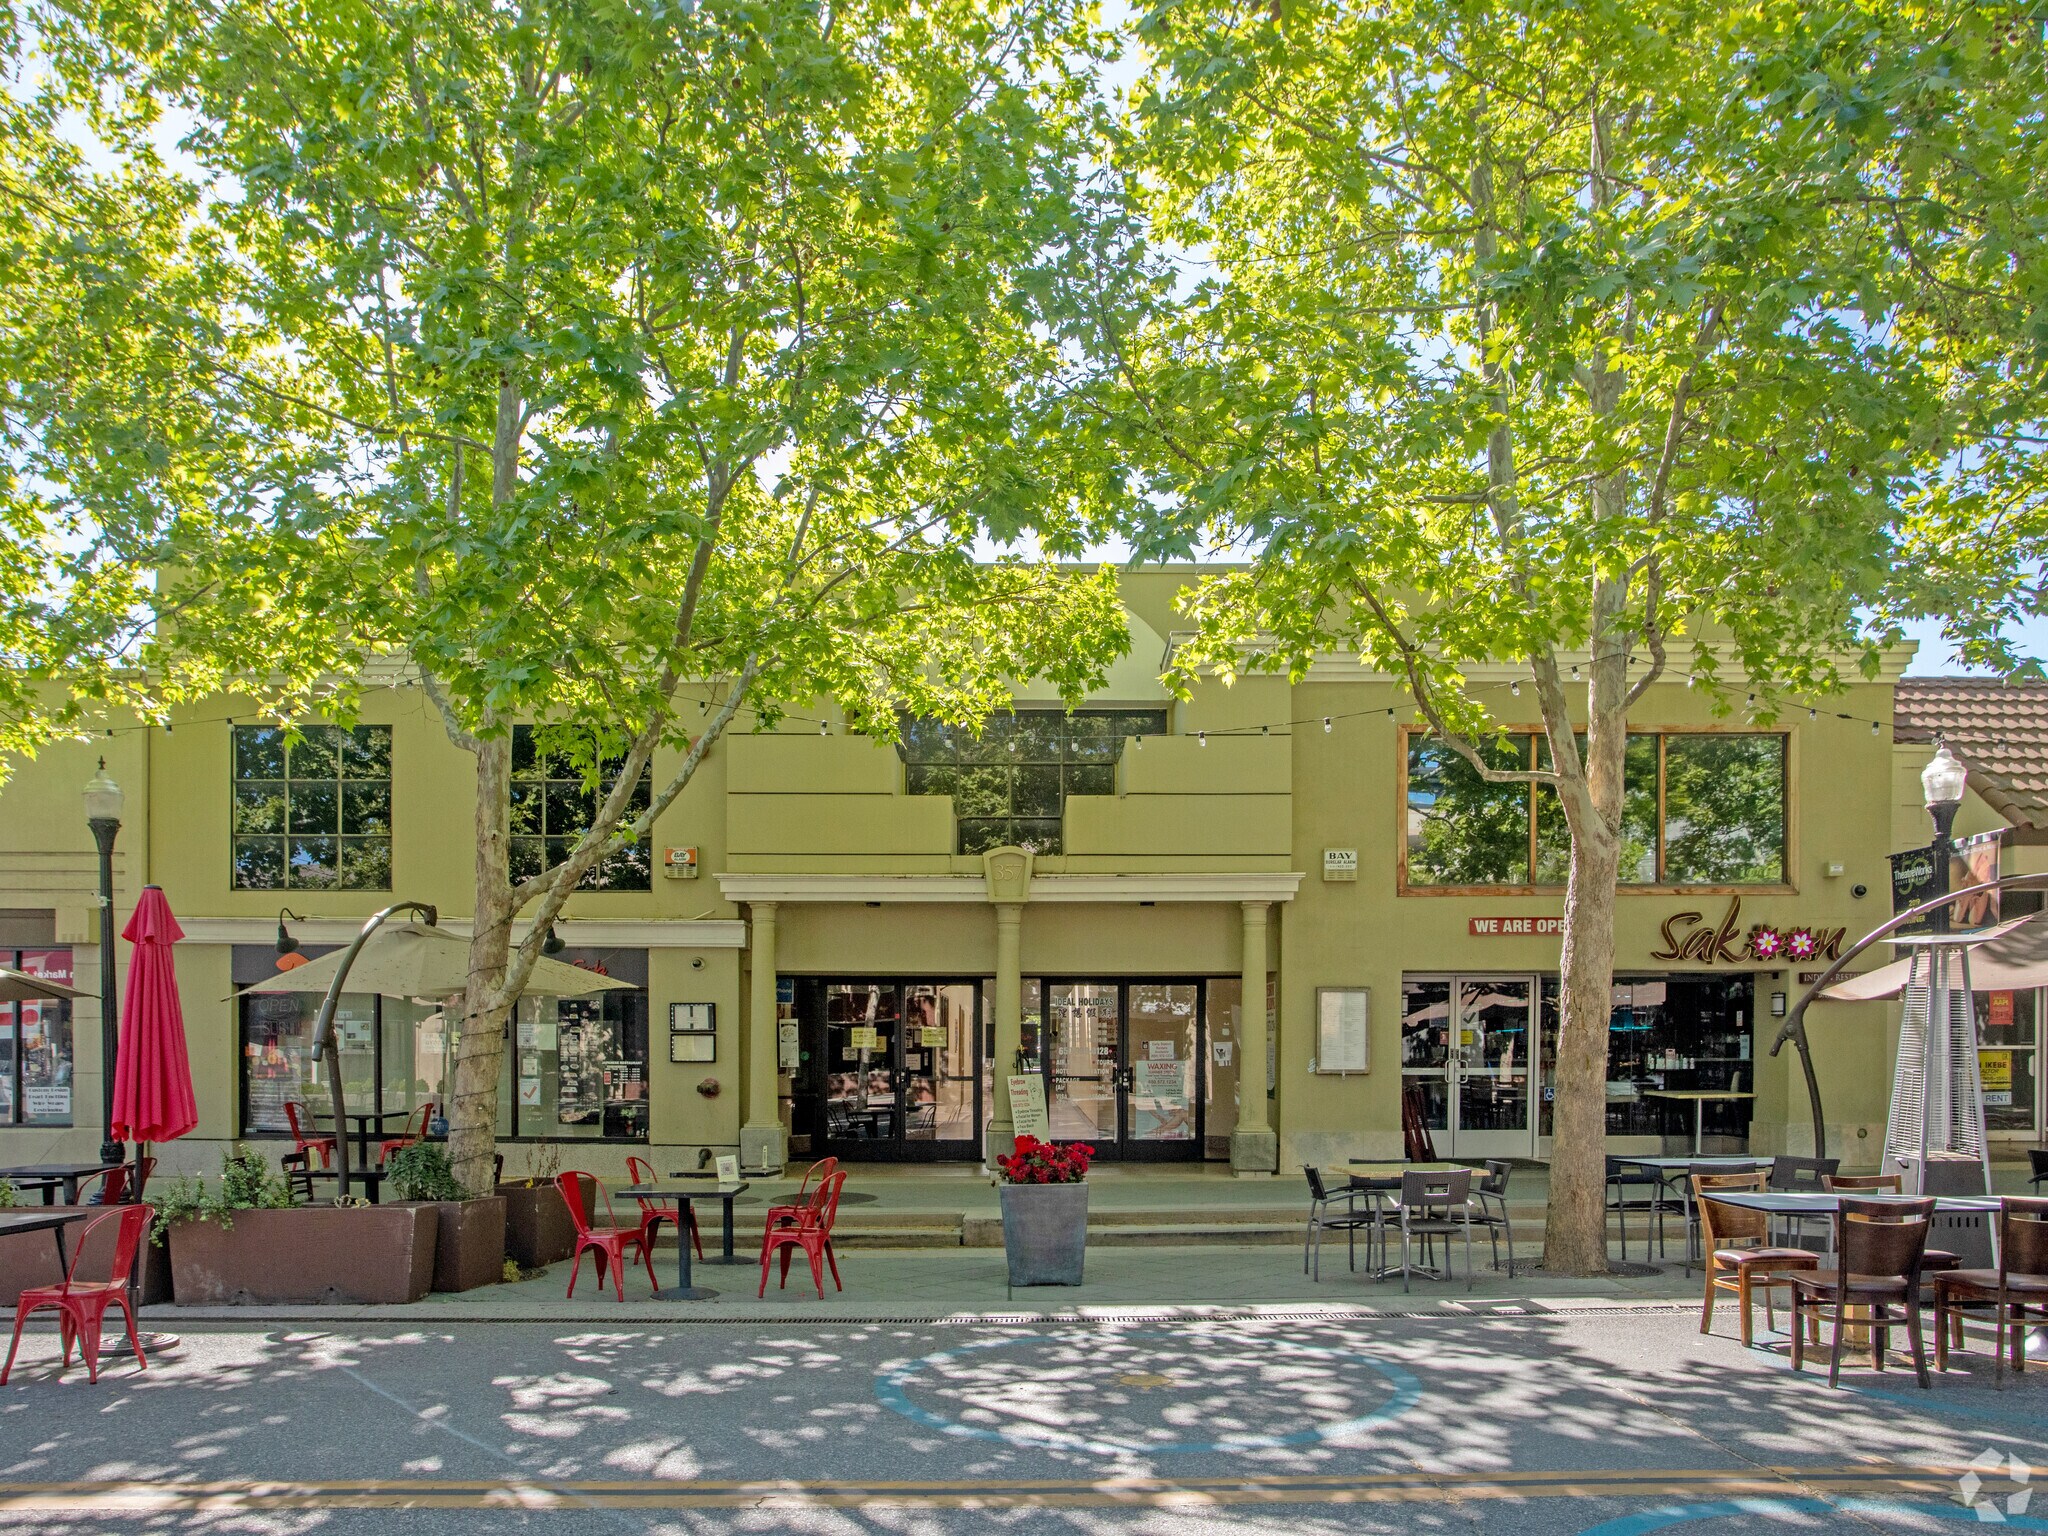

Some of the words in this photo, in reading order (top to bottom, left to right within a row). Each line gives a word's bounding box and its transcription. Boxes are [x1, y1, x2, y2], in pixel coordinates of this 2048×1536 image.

[1329, 852, 1353, 860] BAY
[993, 863, 1023, 881] 357
[1893, 864, 1934, 882] TheatreWorks
[1474, 919, 1498, 933] WE
[1502, 919, 1532, 933] ARE
[1536, 919, 1565, 933] OPE
[259, 998, 300, 1012] OPEN
[1055, 997, 1076, 1006] IDEAL
[1078, 997, 1114, 1006] HOLIDAYS
[1985, 1061, 2007, 1069] IKEBE
[1010, 1078, 1026, 1086] Eyebrow
[1985, 1094, 2009, 1102] RENT
